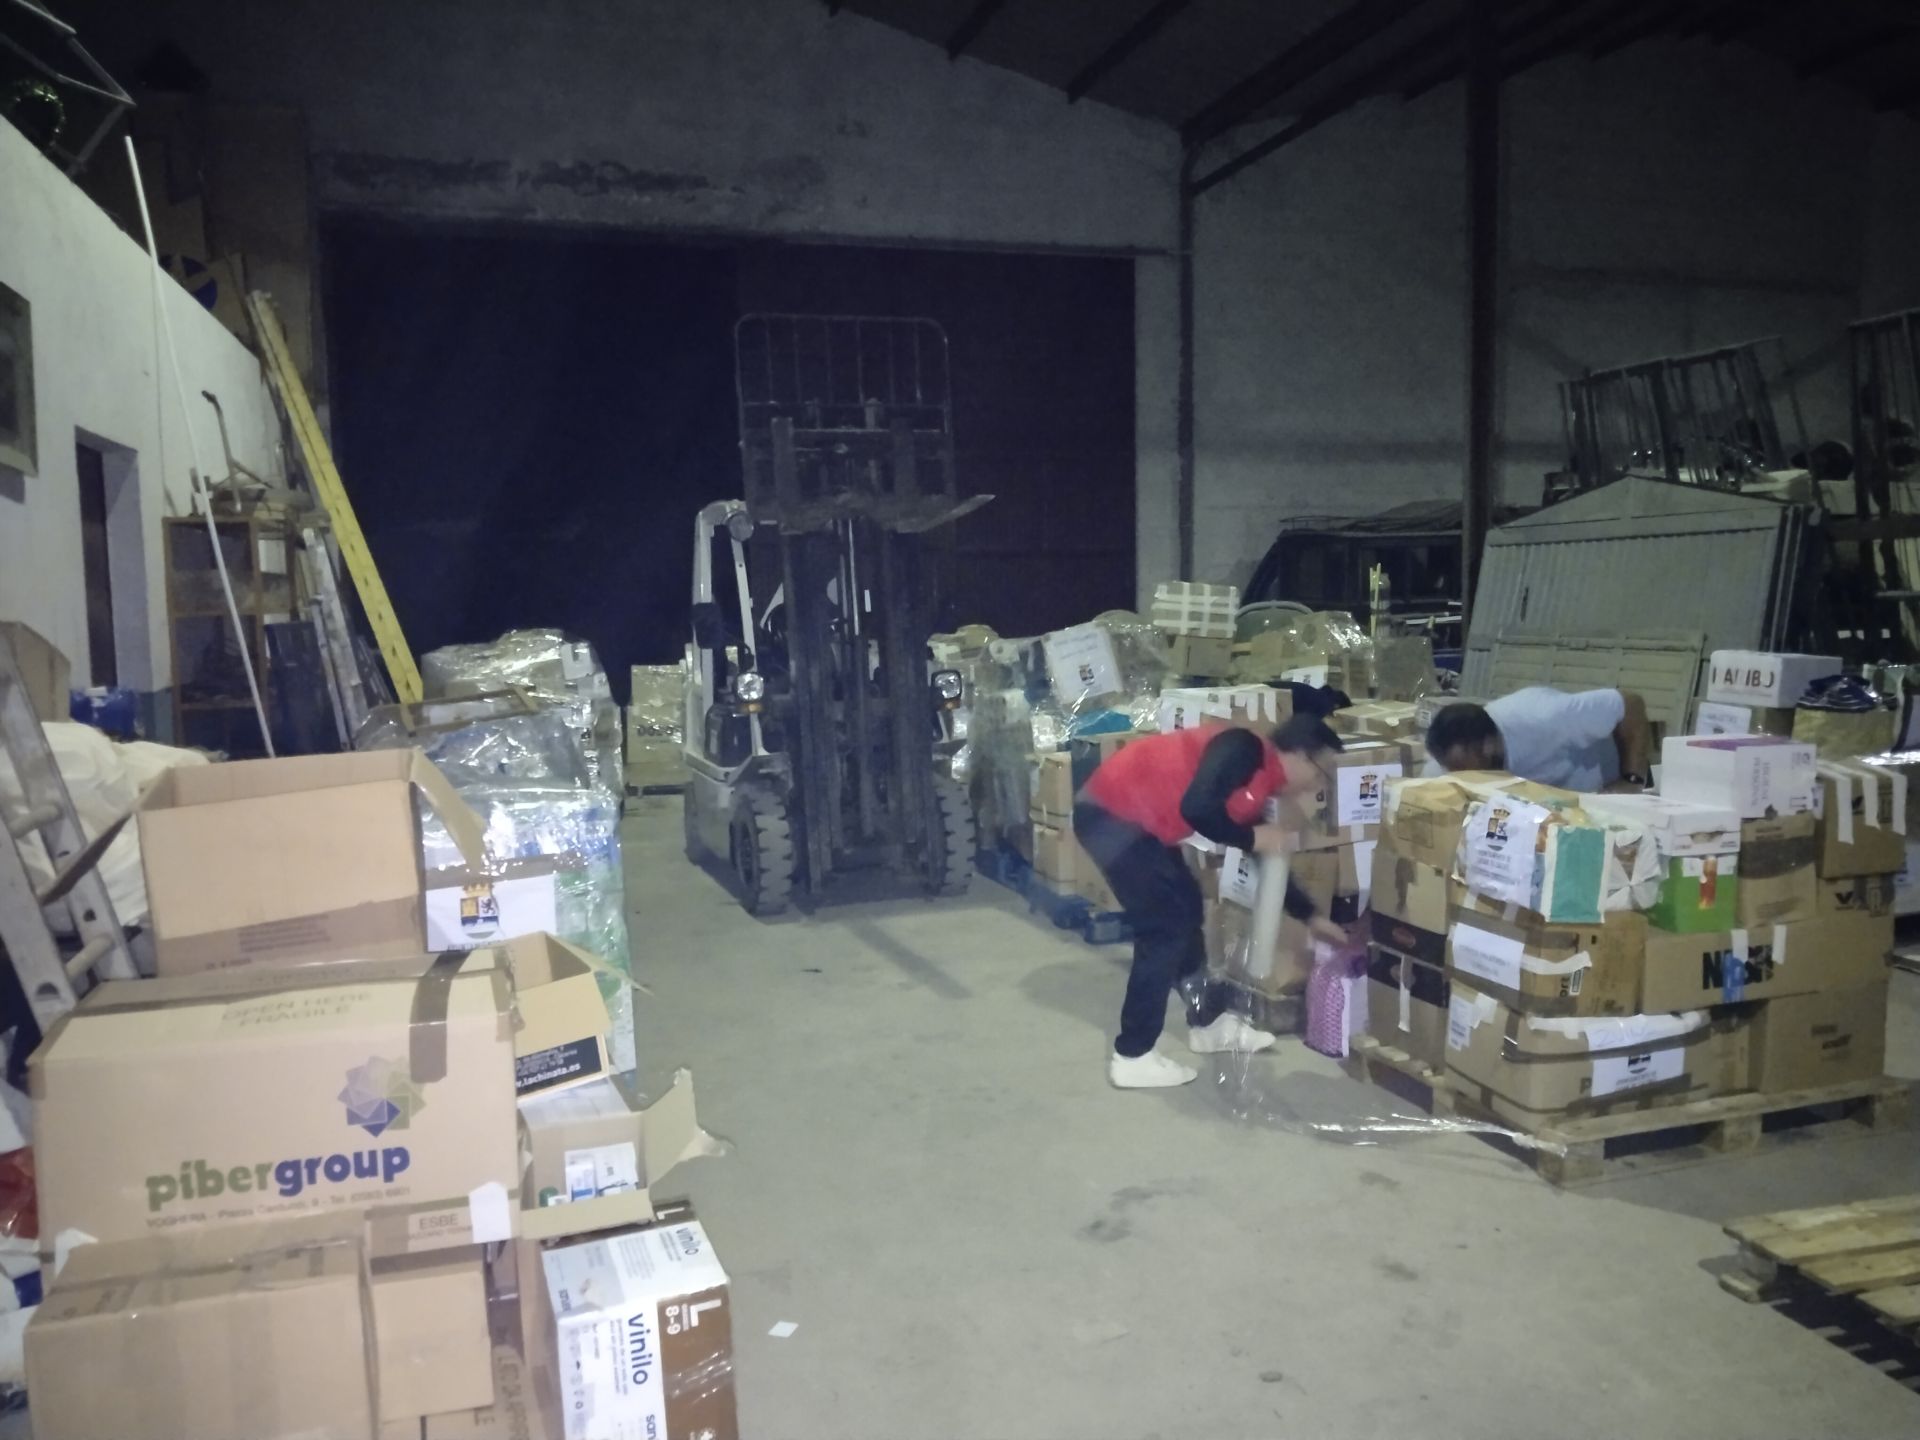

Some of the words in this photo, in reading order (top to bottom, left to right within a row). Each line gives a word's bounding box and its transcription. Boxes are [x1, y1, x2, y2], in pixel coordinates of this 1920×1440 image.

[1712, 667, 1775, 688] AIB
[145, 1146, 411, 1212] pibergroup
[419, 1212, 459, 1231] ESBE
[665, 1304, 681, 1336] 8-9
[689, 1299, 722, 1328] L
[627, 1312, 653, 1386] vinilo
